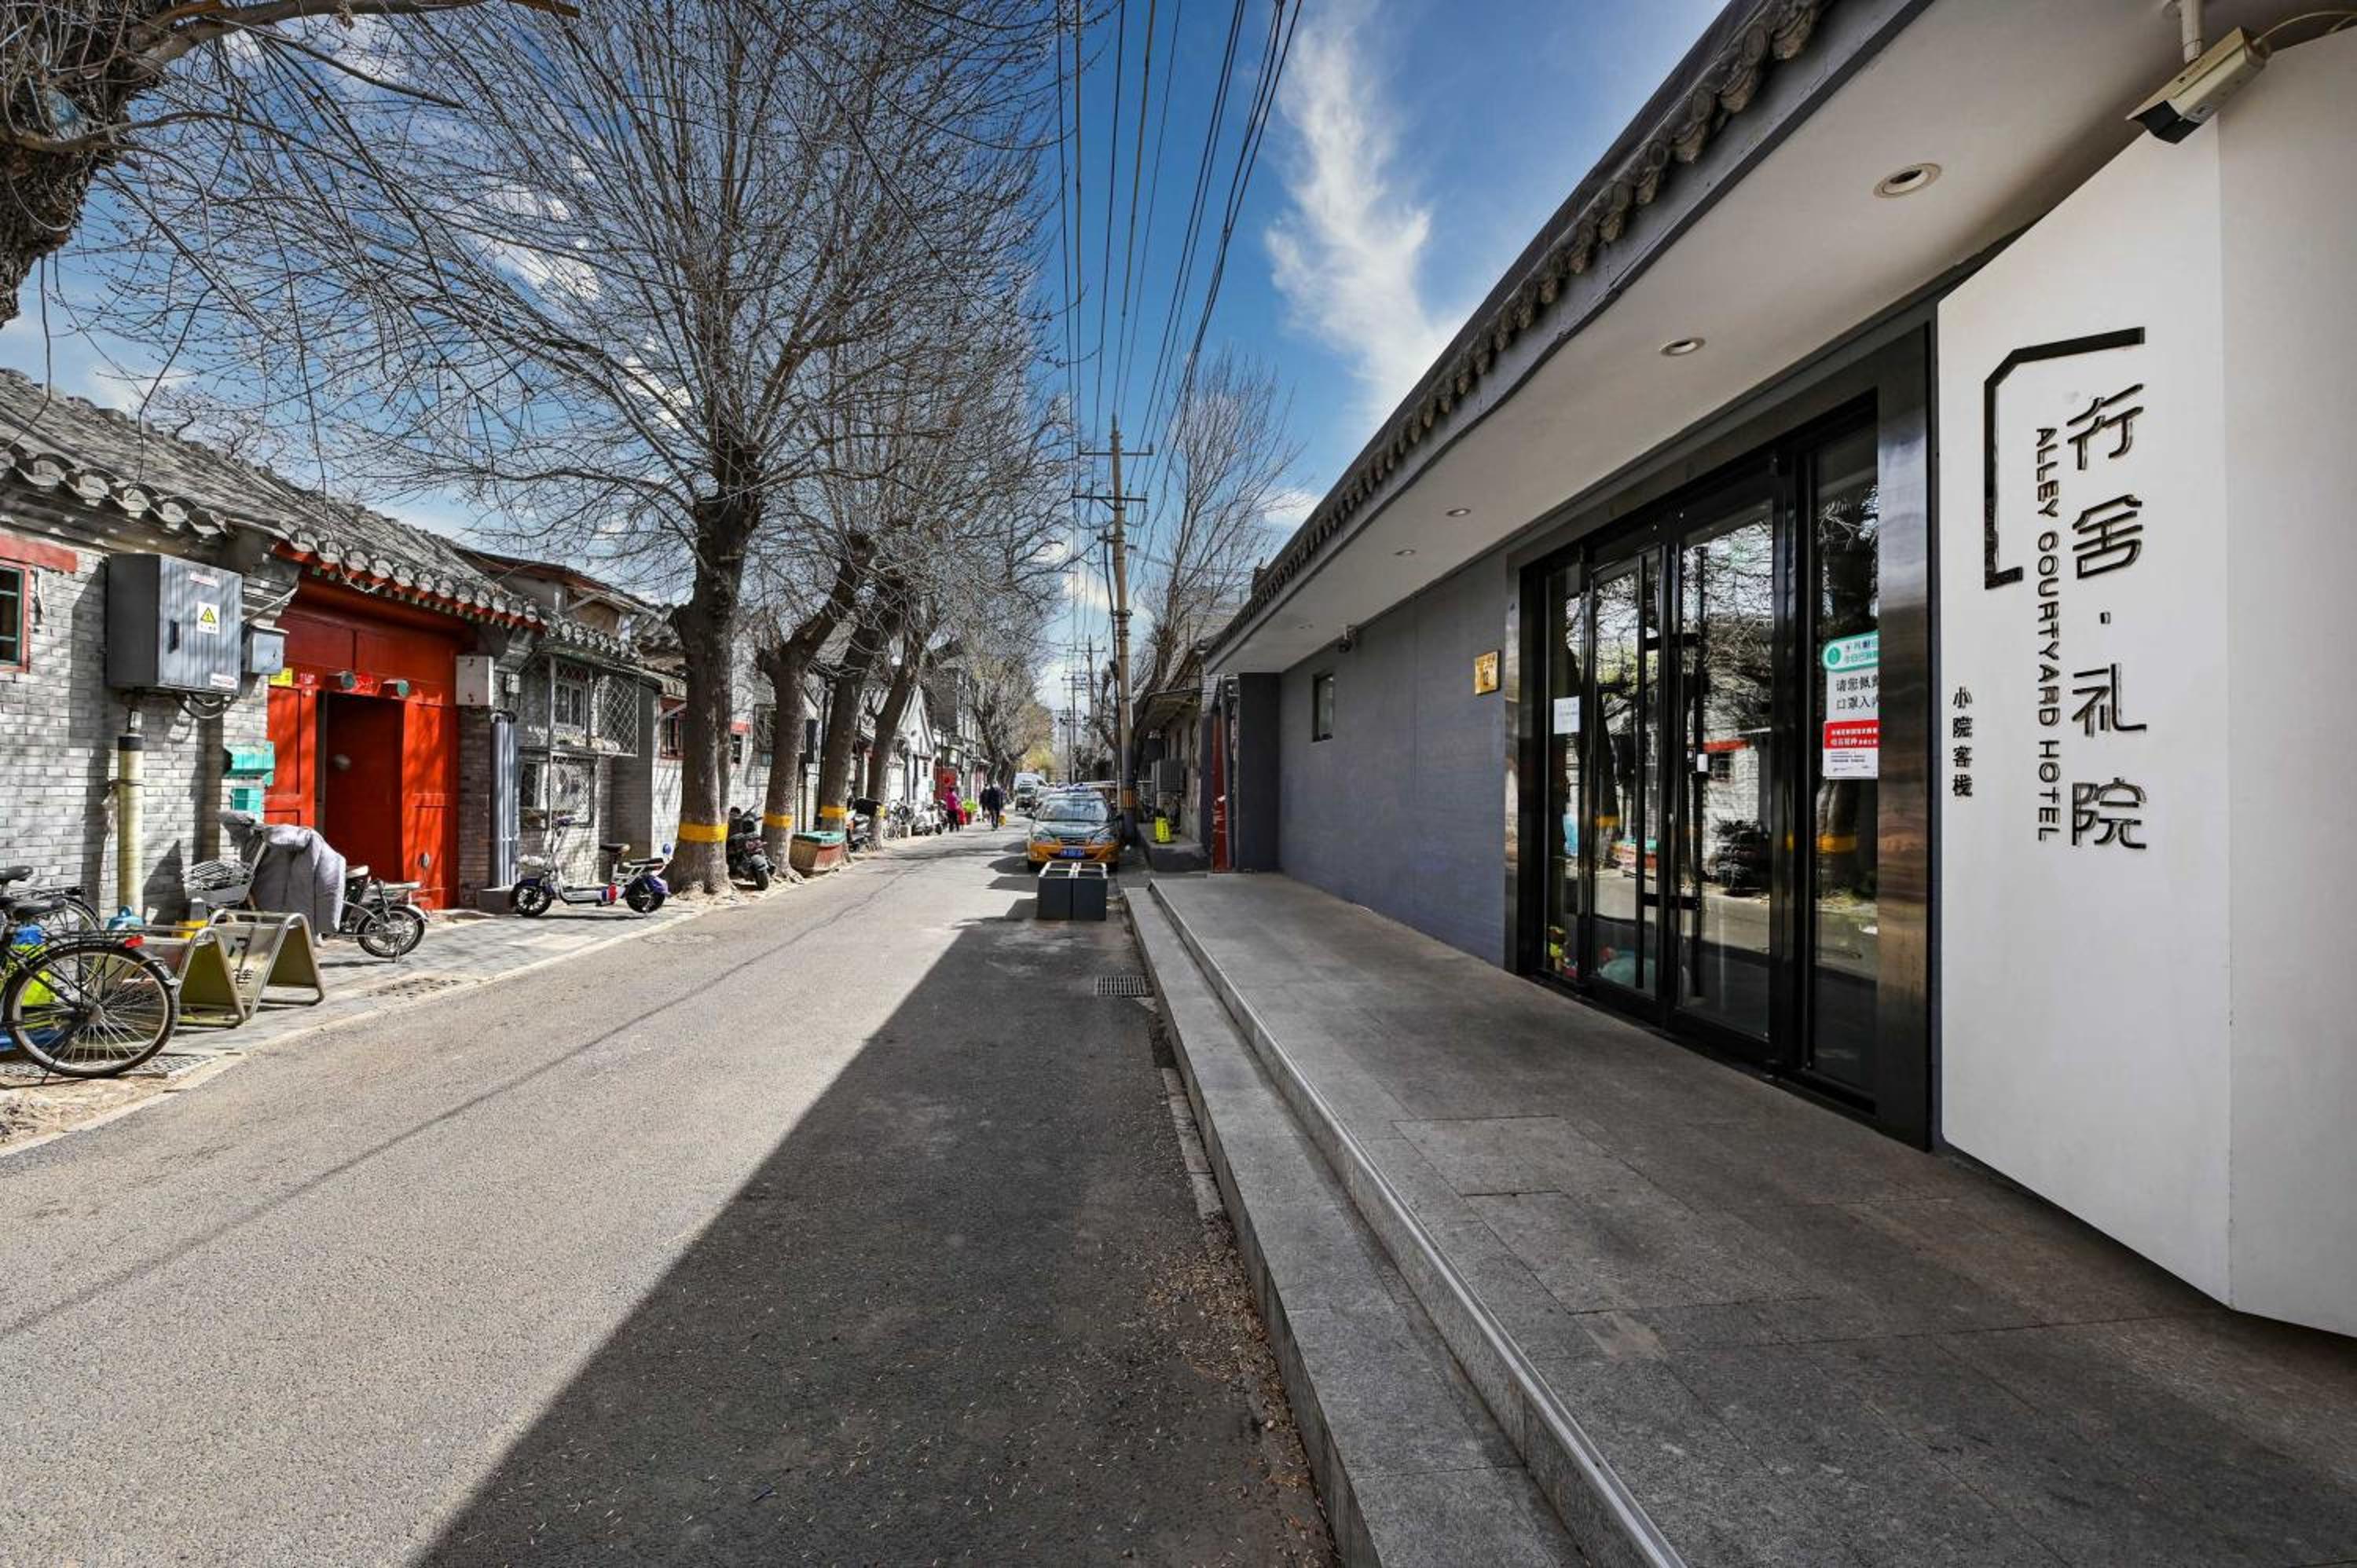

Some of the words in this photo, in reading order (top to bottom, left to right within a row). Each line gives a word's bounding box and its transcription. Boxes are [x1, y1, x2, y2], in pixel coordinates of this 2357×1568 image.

[2035, 427, 2058, 518] ALLEY
[2036, 530, 2062, 728] COURTYARD
[2066, 382, 2147, 850] 行舍·礼院
[1952, 686, 1974, 798] 小院客栈
[2038, 739, 2062, 843] HOTEL
